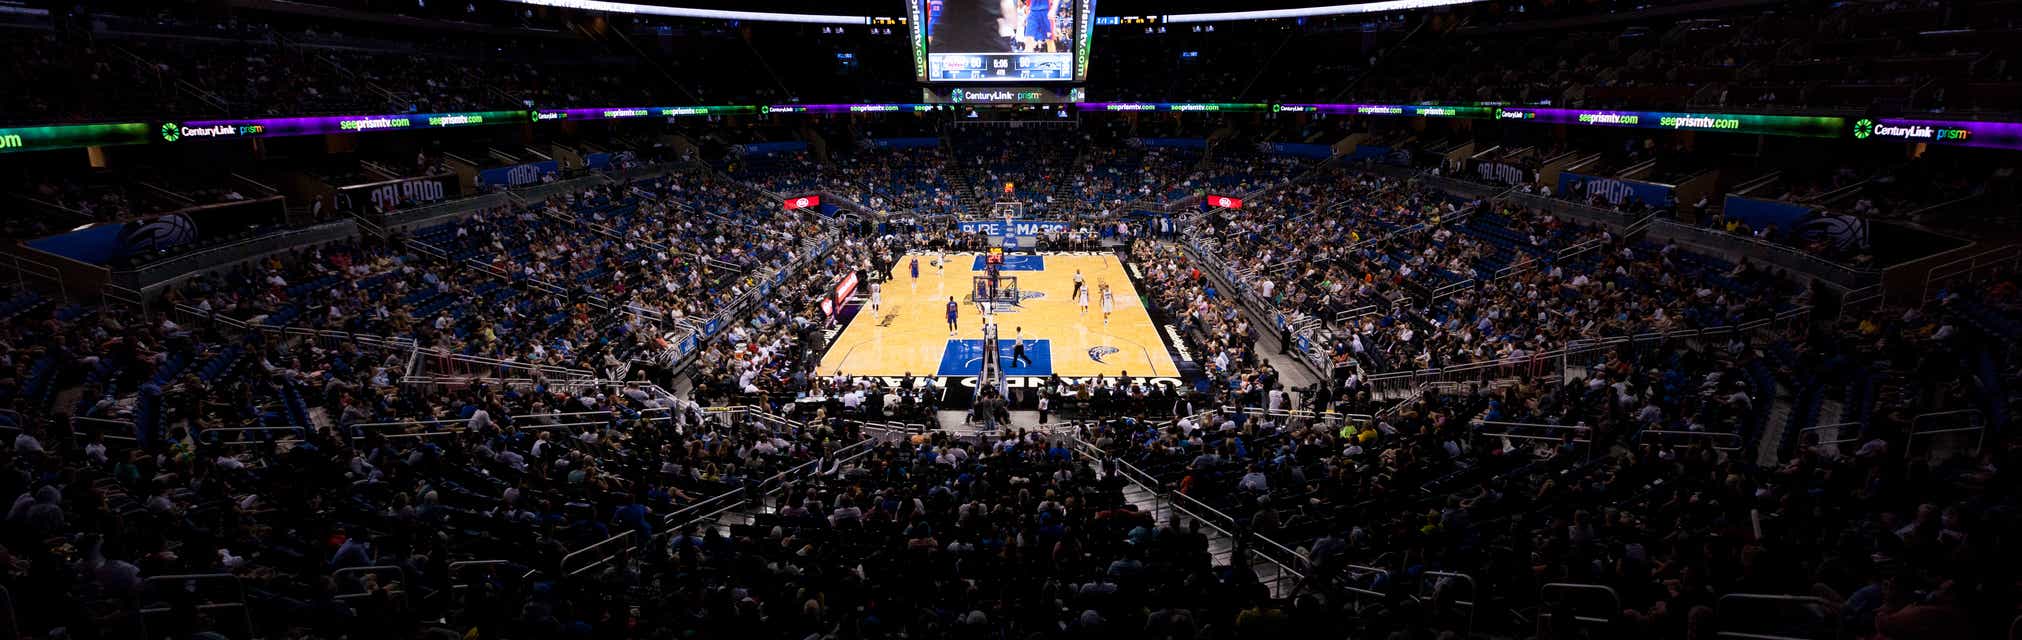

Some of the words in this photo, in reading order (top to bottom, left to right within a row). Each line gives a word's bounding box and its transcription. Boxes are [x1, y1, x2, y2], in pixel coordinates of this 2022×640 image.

[965, 91, 1014, 101] CenturyLink
[1018, 91, 1039, 101] prism
[1107, 103, 1155, 112] seeprismtv.com
[1171, 103, 1219, 112] seeprismtv.com
[340, 116, 410, 131] seeprismtv.com
[429, 114, 483, 127] seeprismtv.com
[1578, 112, 1639, 126] seeprismtv.com
[1660, 115, 1739, 130] seeprismtv.com
[181, 125, 236, 138] CenturyLink
[240, 125, 265, 137] prism
[1874, 124, 1935, 139] CenturyLink
[1937, 128, 1971, 141] prism
